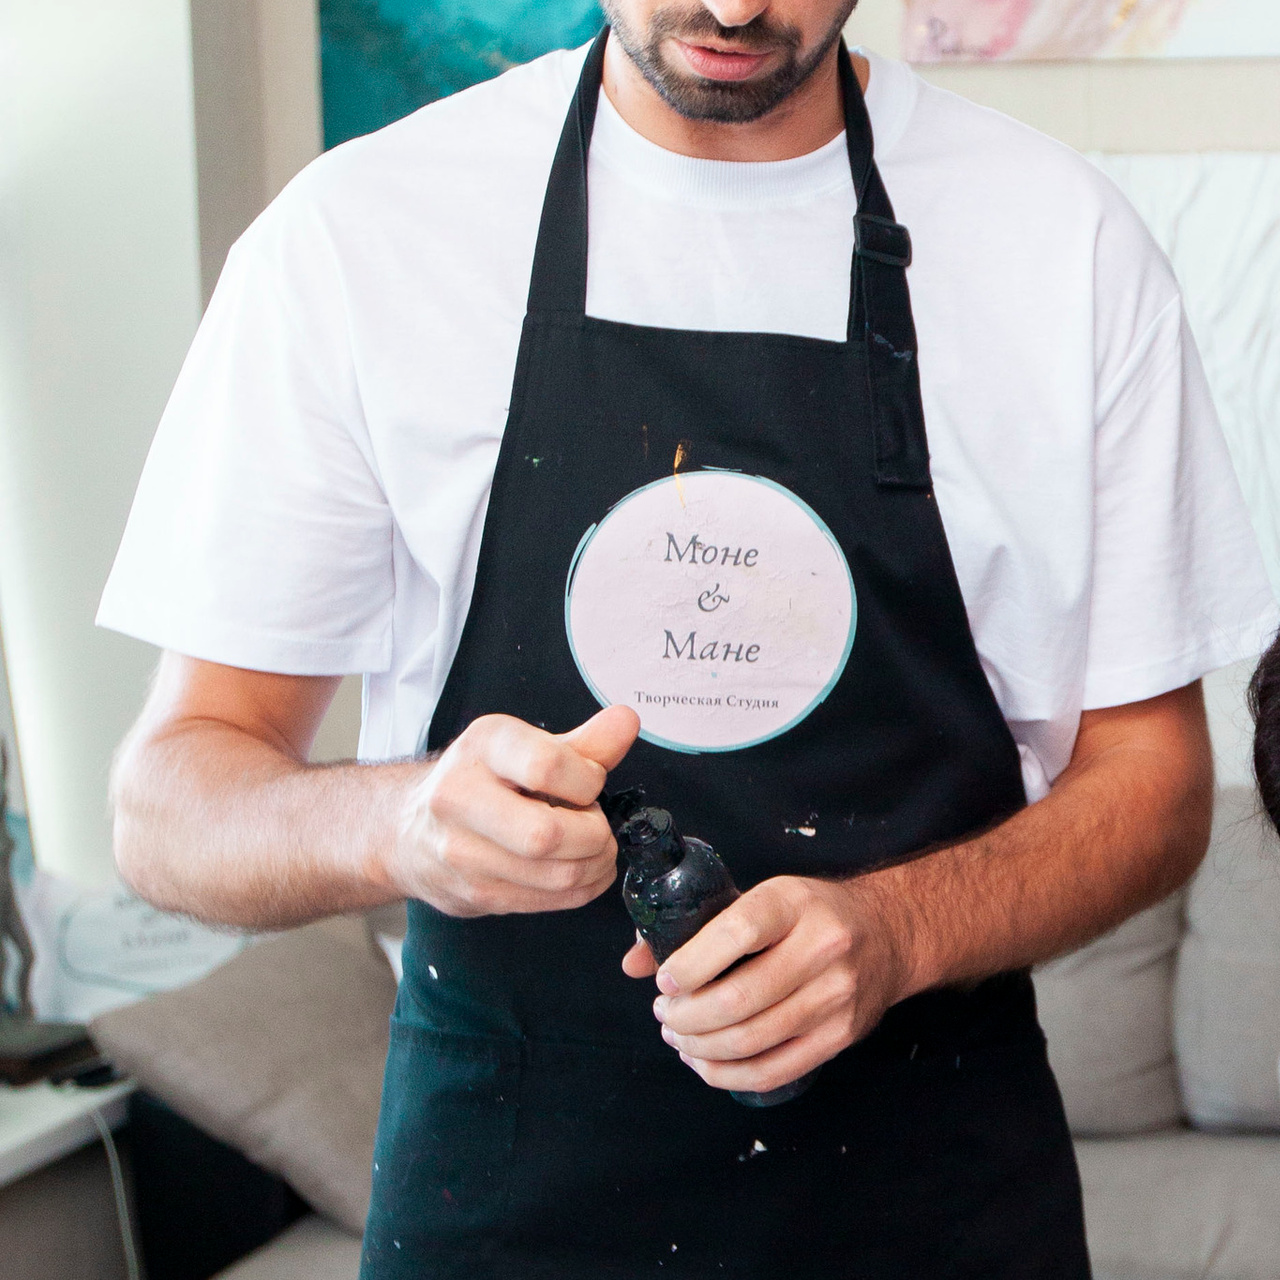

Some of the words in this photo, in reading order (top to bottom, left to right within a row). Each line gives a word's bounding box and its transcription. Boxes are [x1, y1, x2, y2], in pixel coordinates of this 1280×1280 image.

[664, 532, 759, 567] Моне
[697, 583, 730, 613] &
[662, 630, 760, 663] Мане
[634, 691, 722, 708] Творческая
[726, 695, 779, 710] Студия
